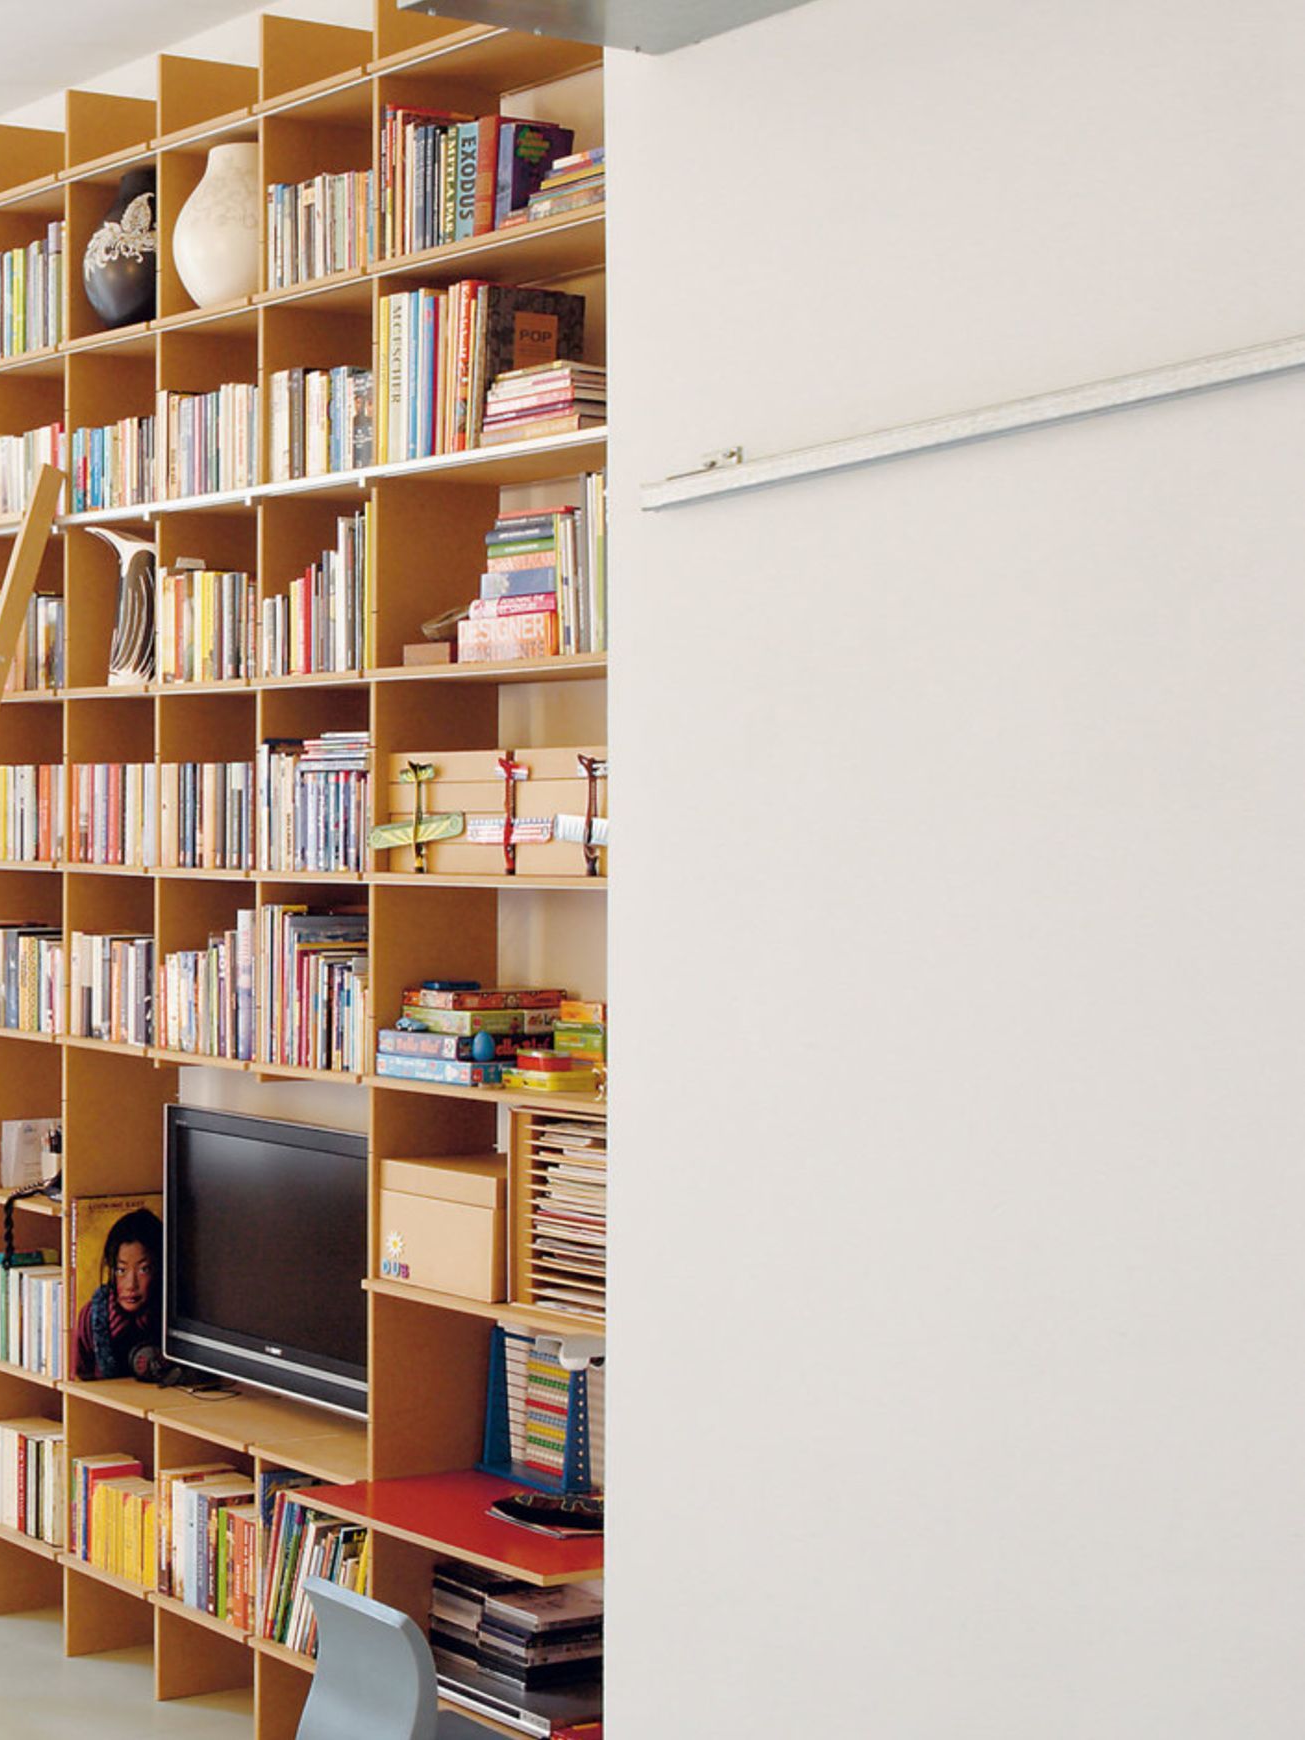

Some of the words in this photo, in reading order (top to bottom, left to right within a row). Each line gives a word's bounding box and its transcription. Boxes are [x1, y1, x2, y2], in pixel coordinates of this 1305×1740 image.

[459, 136, 477, 220] EXODUS
[519, 329, 552, 343] POP
[460, 615, 543, 643] DESIGNER
